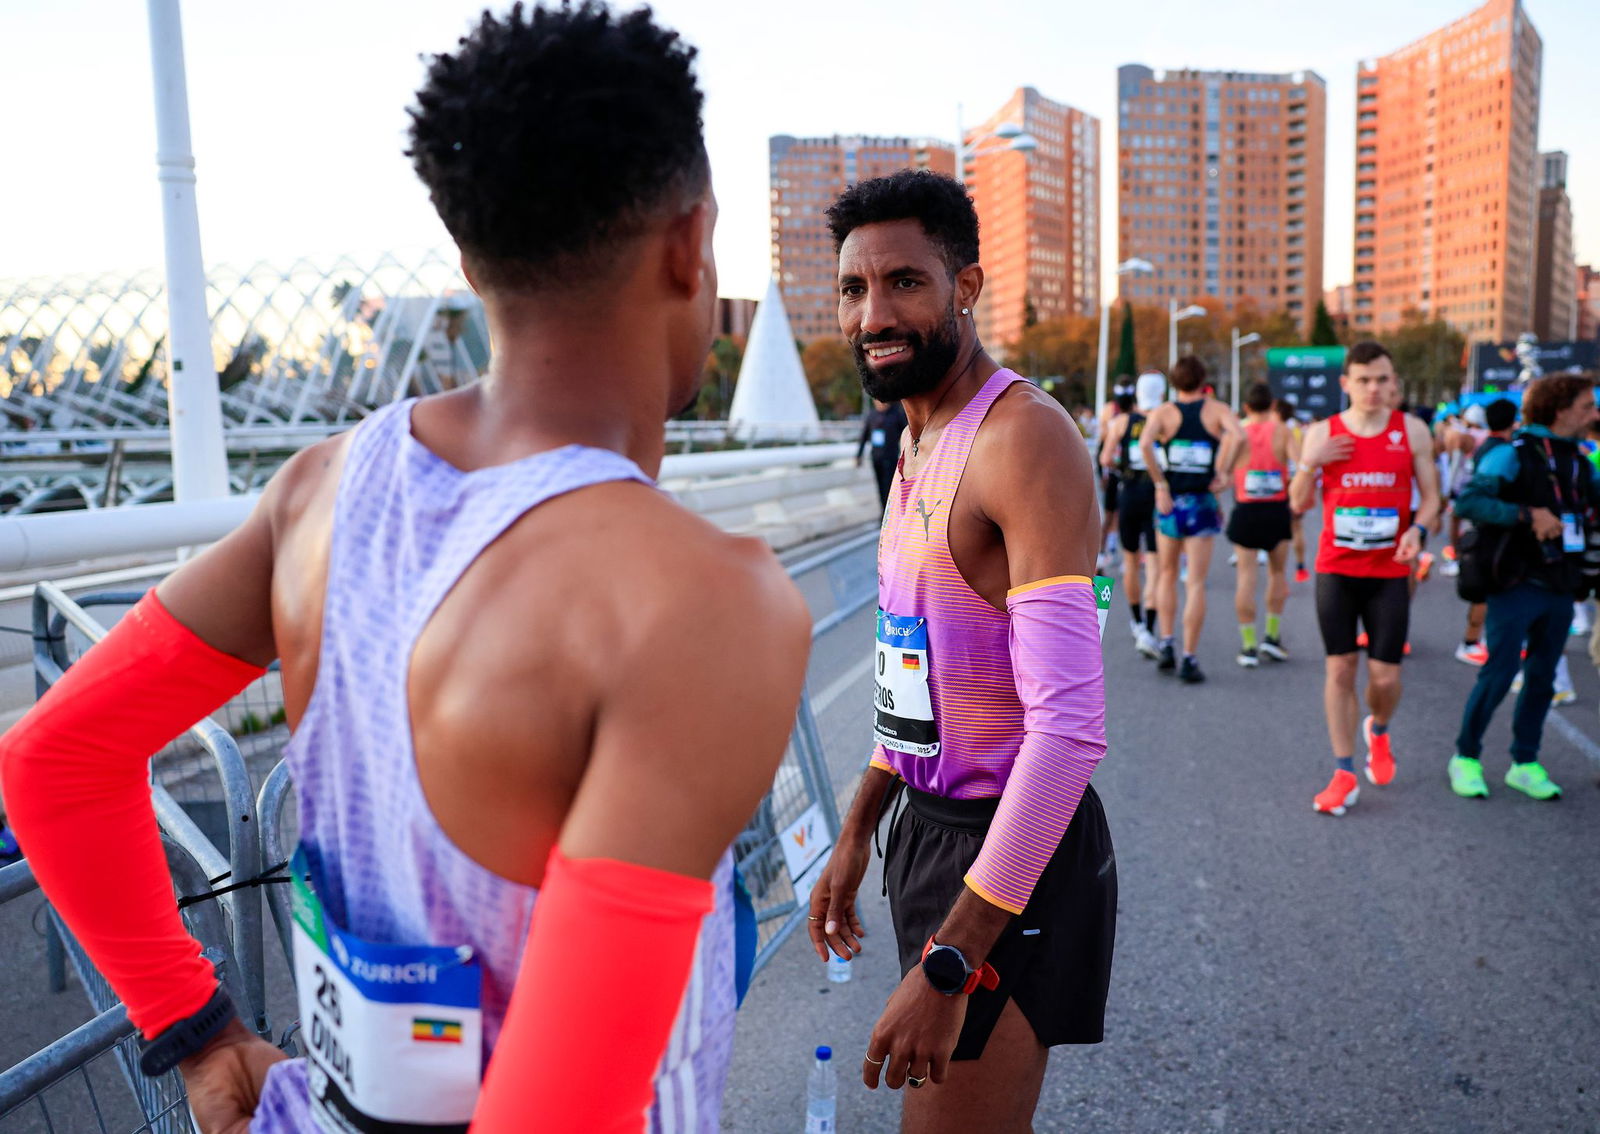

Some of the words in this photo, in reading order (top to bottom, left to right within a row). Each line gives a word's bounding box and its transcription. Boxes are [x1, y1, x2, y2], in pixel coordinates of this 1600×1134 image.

[1341, 472, 1396, 487] CYMRU
[351, 959, 437, 983] ZURICH
[312, 1012, 357, 1094] DIDA
